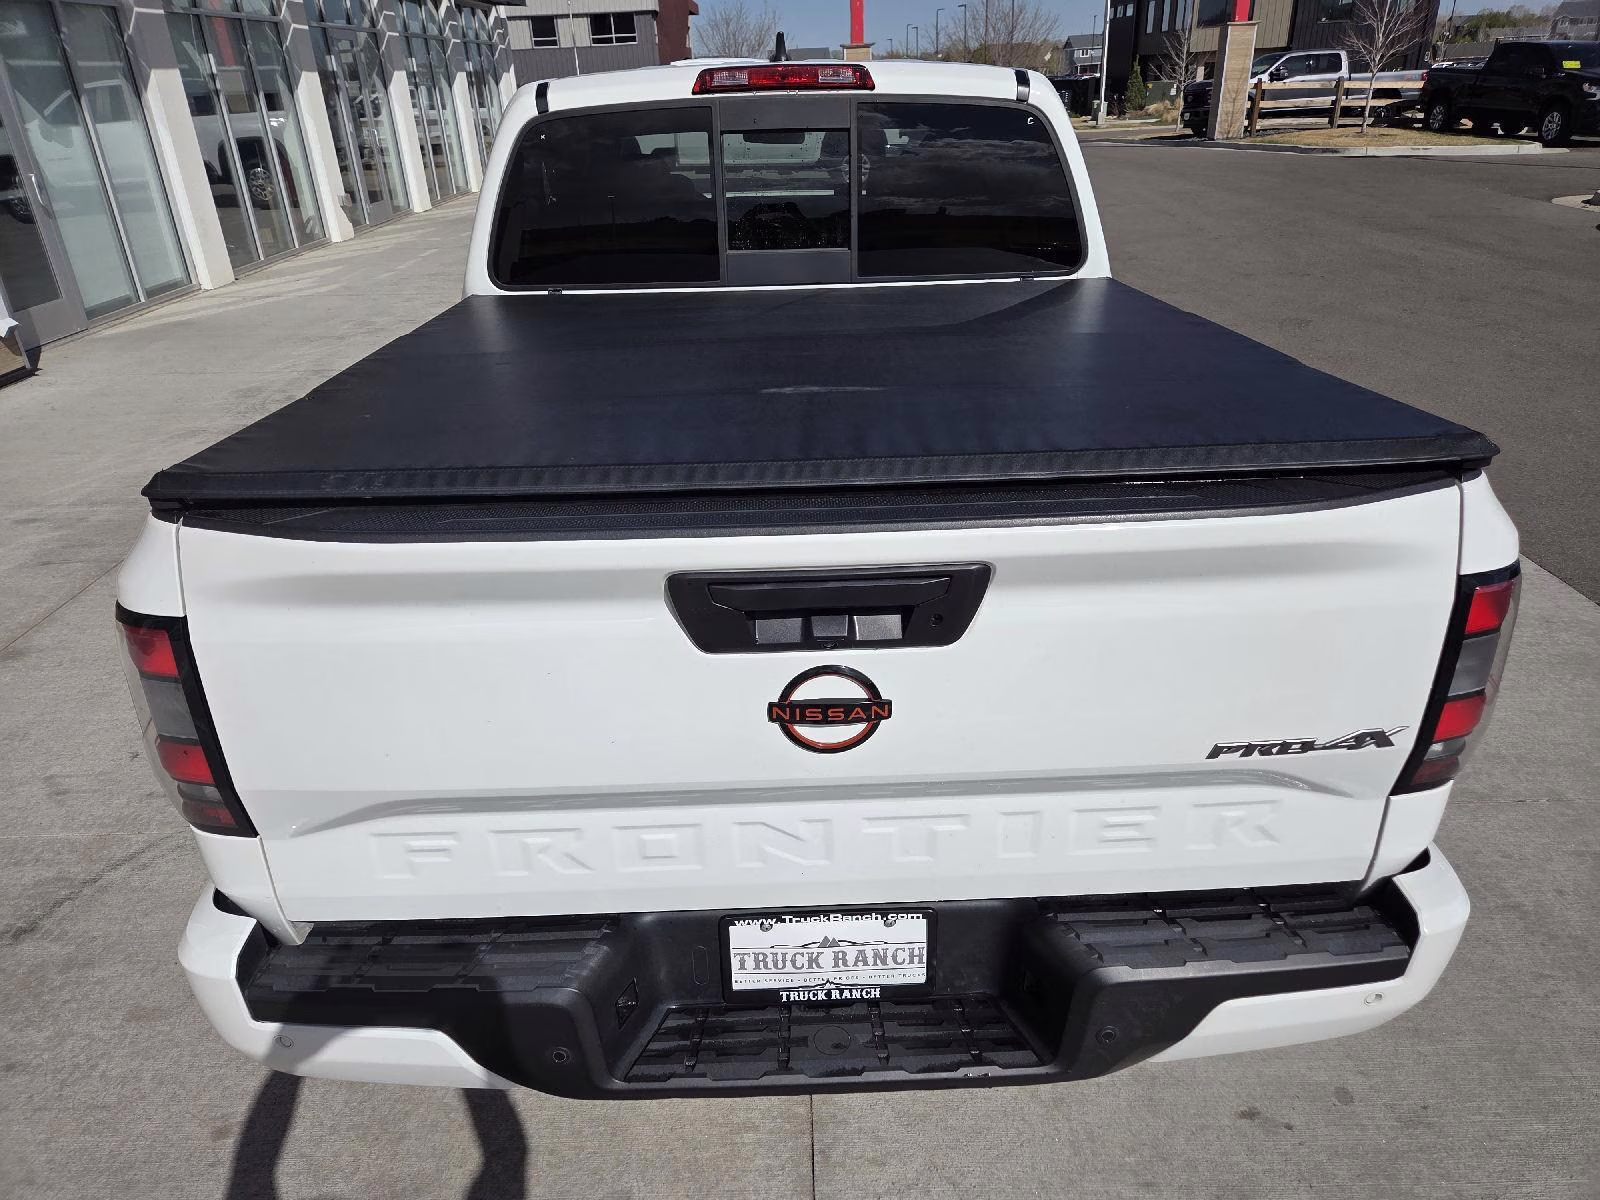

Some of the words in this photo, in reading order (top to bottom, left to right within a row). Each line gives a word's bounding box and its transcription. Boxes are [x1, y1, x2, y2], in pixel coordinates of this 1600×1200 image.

[771, 704, 889, 721] NISSAN
[367, 799, 1283, 880] FRONTIER
[734, 912, 923, 927] www.TruckRanch.com
[733, 951, 825, 971] TRUCK
[831, 946, 926, 969] RANCH
[779, 989, 829, 1002] TRUCK
[830, 987, 881, 1000] RANCH
